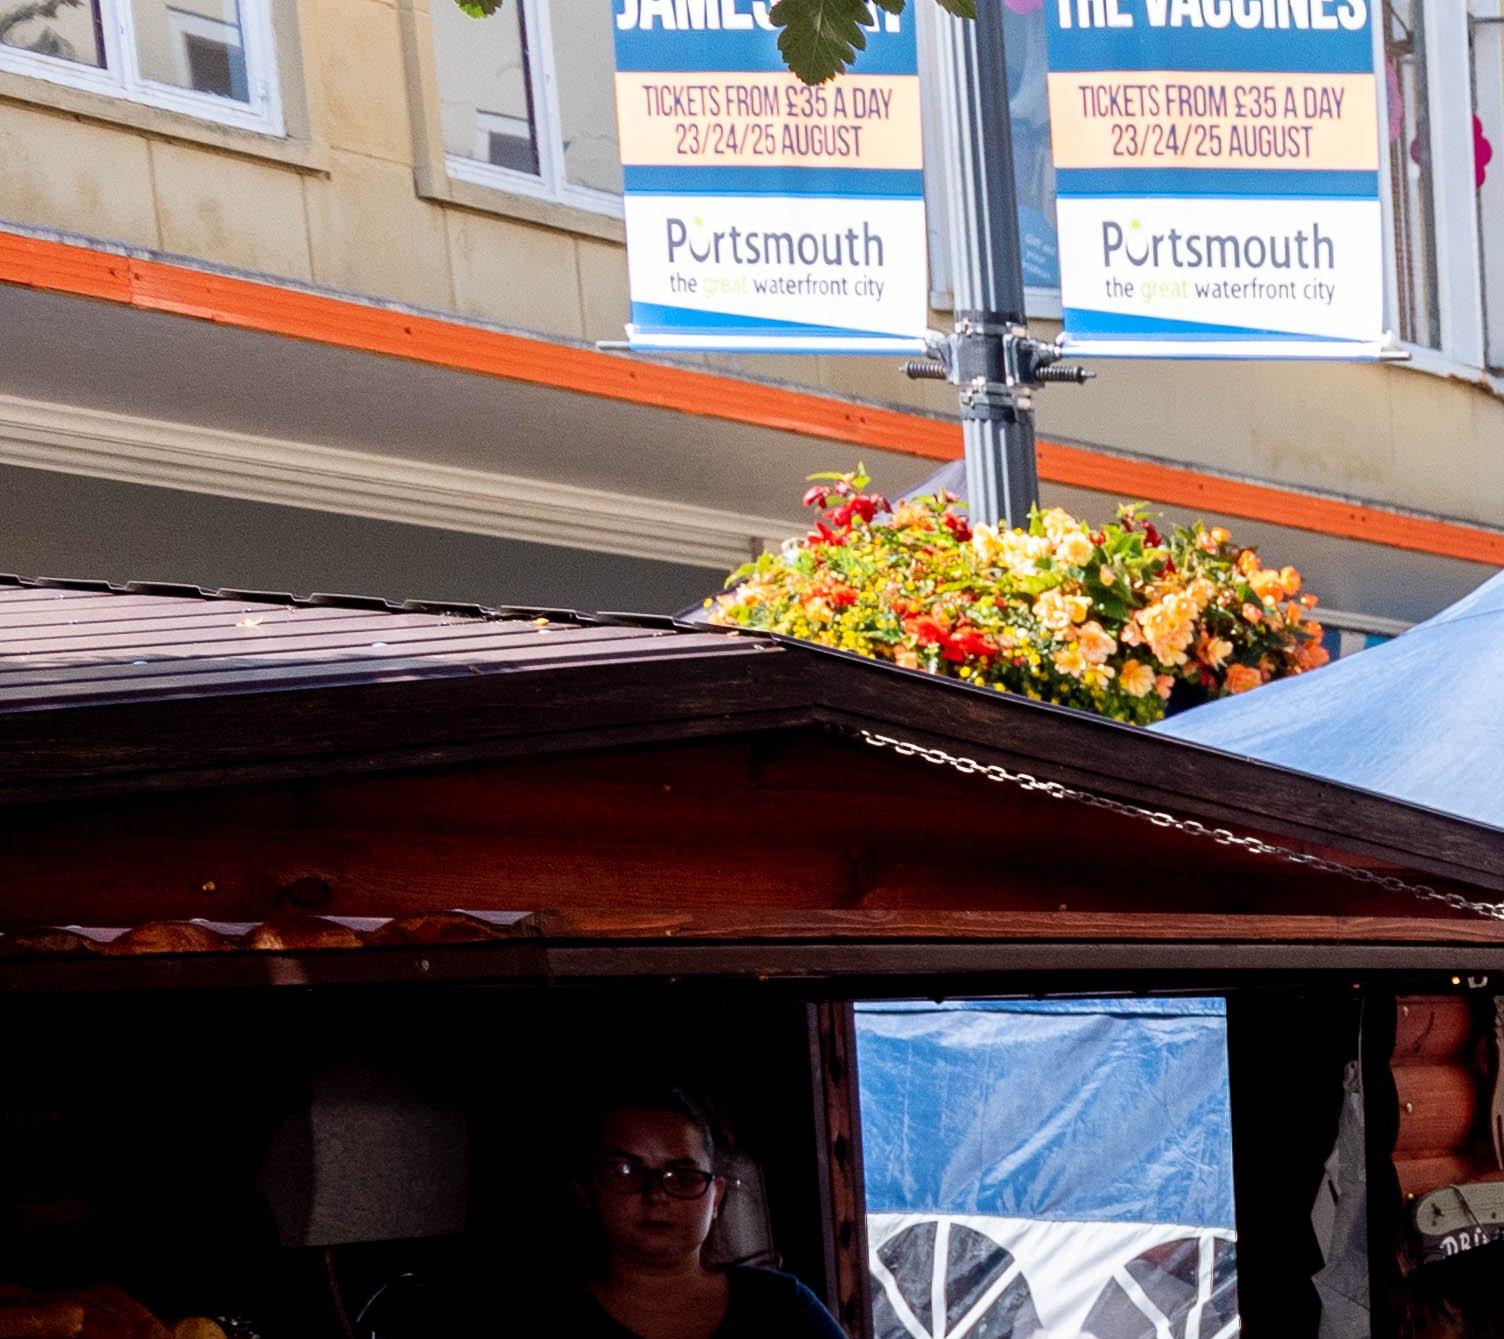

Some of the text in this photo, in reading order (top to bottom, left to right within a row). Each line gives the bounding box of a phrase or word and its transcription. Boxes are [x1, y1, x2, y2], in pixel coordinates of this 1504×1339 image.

[643, 85, 893, 120] TICKETS FROM £35 A DAY
[1078, 84, 1345, 119] TICKETS FROM £35 A DAY
[675, 123, 863, 157] 23/24/25 AUGUST
[1111, 124, 1313, 158] 23/24/25 AUGUST
[666, 217, 885, 266] Portsmouth
[1102, 218, 1335, 269] Portsmouth
[670, 272, 885, 302] the great waterfront city
[1105, 276, 1336, 305] the great waterfront city
